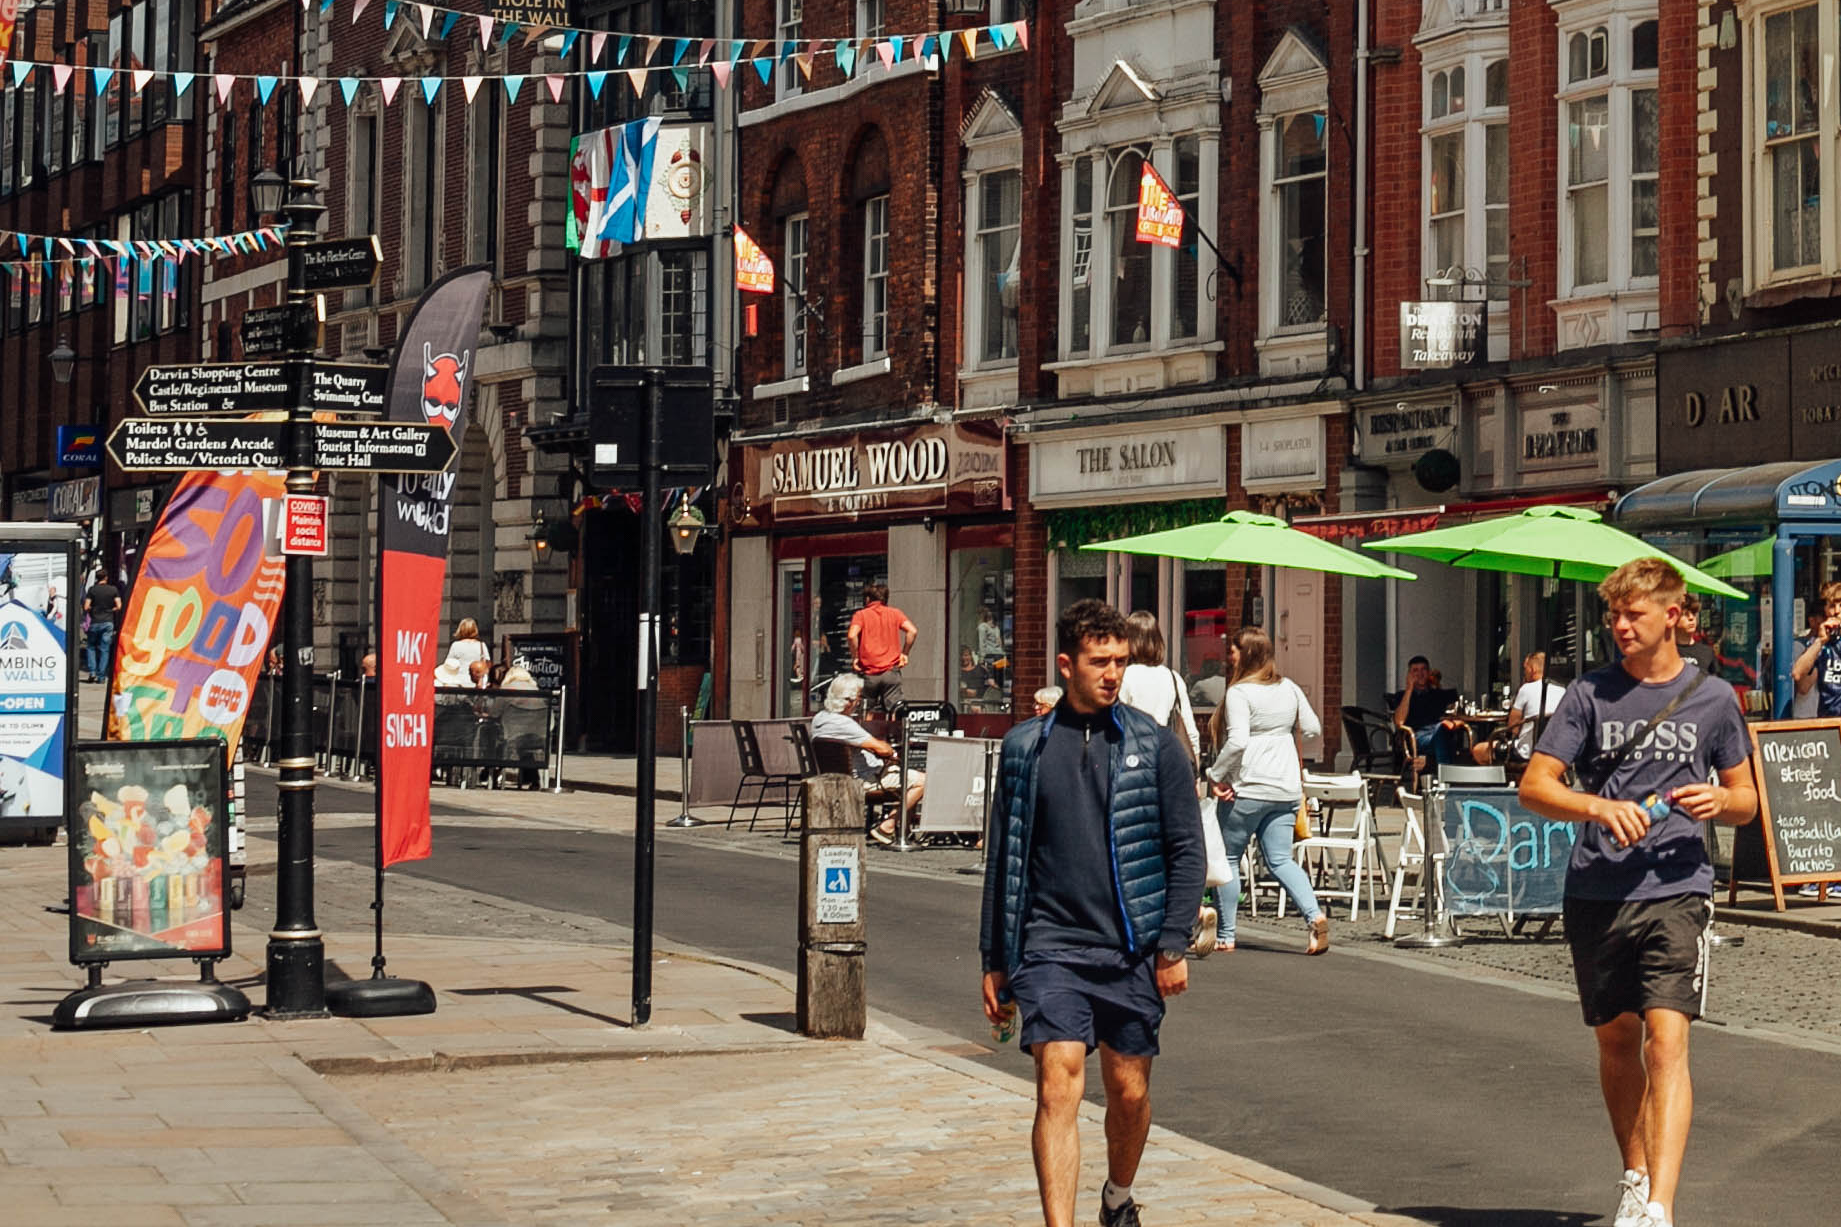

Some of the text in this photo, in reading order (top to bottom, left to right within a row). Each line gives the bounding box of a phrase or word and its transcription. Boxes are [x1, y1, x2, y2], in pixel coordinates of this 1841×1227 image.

[491, 9, 572, 27] THE WALL
[1141, 177, 1168, 211] THE
[150, 365, 281, 382] Darwin Shopping Centre
[244, 382, 287, 392] Museum
[313, 372, 367, 390] The Quarry
[313, 389, 361, 406] Swimming
[149, 399, 209, 412] Bus Station
[125, 422, 168, 434] Toilets
[315, 426, 430, 442] Museum & Art Gallery
[126, 437, 275, 449] Mardol Gardens Arcade
[316, 440, 414, 454] Tourist Information
[63, 454, 97, 462] CORAL
[125, 452, 161, 465] Police
[315, 454, 371, 467] Music Hall
[1076, 440, 1176, 474] THE SALON
[772, 447, 859, 492] SAMUEL
[866, 437, 948, 485] WOOD
[53, 481, 85, 514] CORAL
[828, 493, 889, 512] & COMPANY
[291, 515, 322, 526] Maintain
[295, 526, 318, 536] social
[290, 536, 322, 547] distance
[3, 670, 56, 681] WALLS
[908, 710, 940, 722] OPEN
[1601, 719, 1697, 752] BOSS
[1763, 740, 1830, 763] Mexican
[1780, 763, 1822, 783] street
[1777, 814, 1807, 828] tacos
[1789, 859, 1836, 873] nachos
